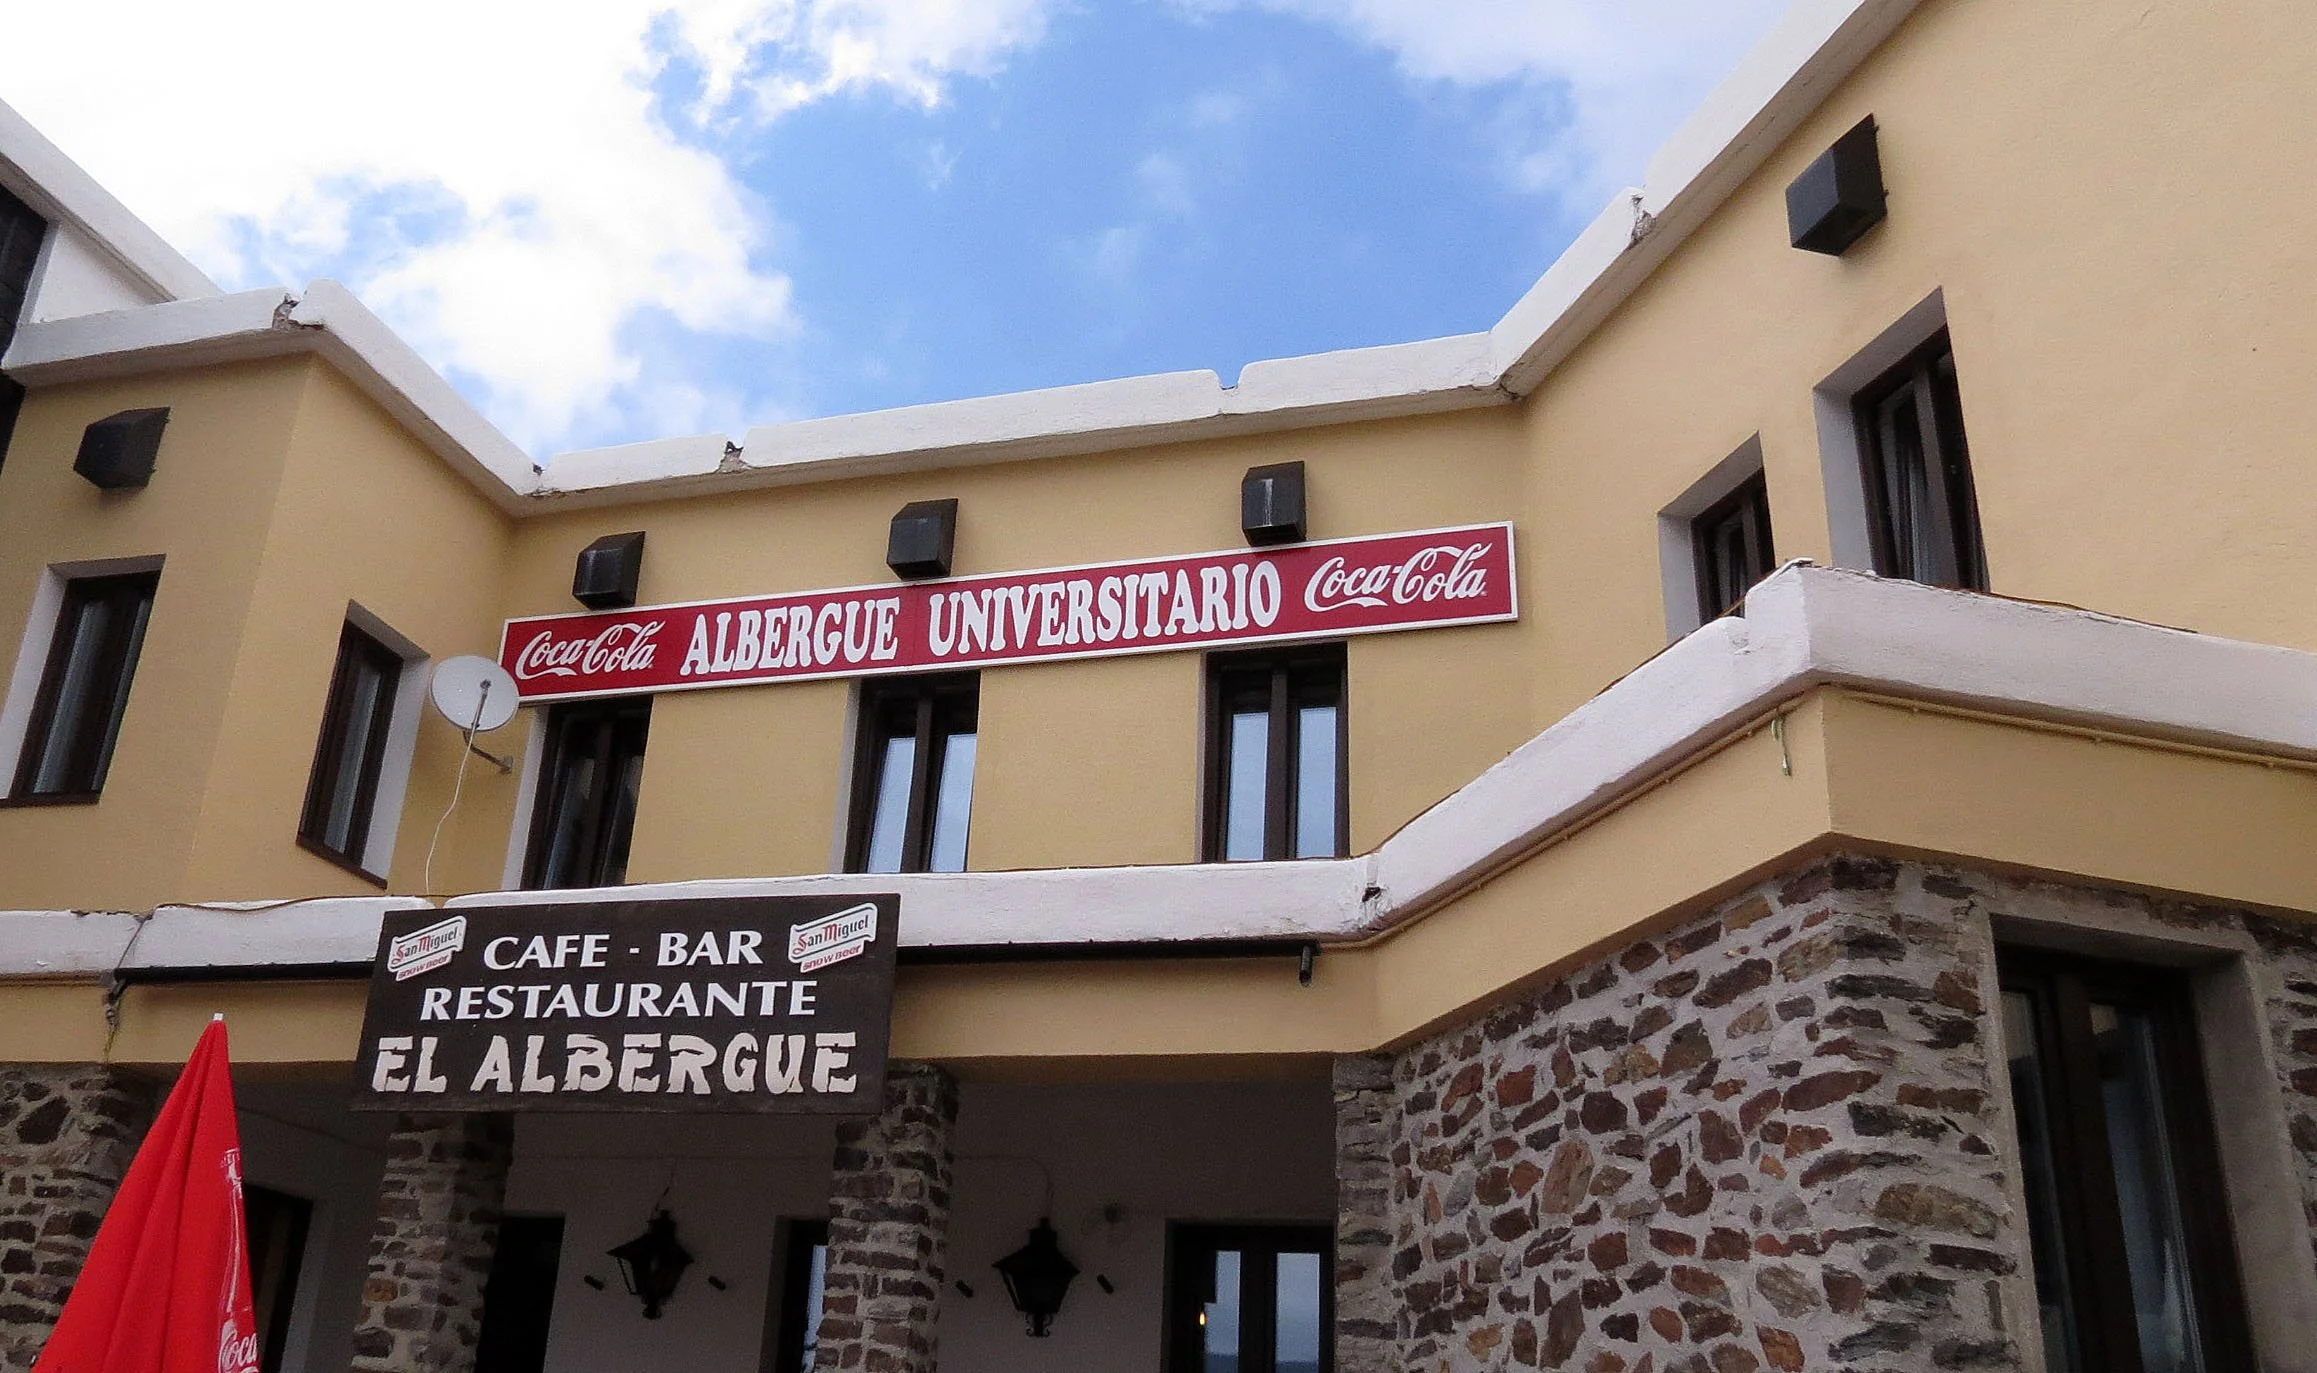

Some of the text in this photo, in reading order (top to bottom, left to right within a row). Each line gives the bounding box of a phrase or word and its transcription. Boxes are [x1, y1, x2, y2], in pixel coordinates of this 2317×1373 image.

[514, 542, 1493, 680] Coca-Cola ALBERGUE UNIVERSITARIO Coca-Cola
[418, 926, 459, 952] Miguel
[484, 934, 611, 971] CAFE
[657, 930, 764, 968] BAR
[791, 914, 869, 956] San Miguel
[420, 980, 818, 1021] RESTAURANTE
[371, 1031, 858, 1095] EL ALBERGUE
